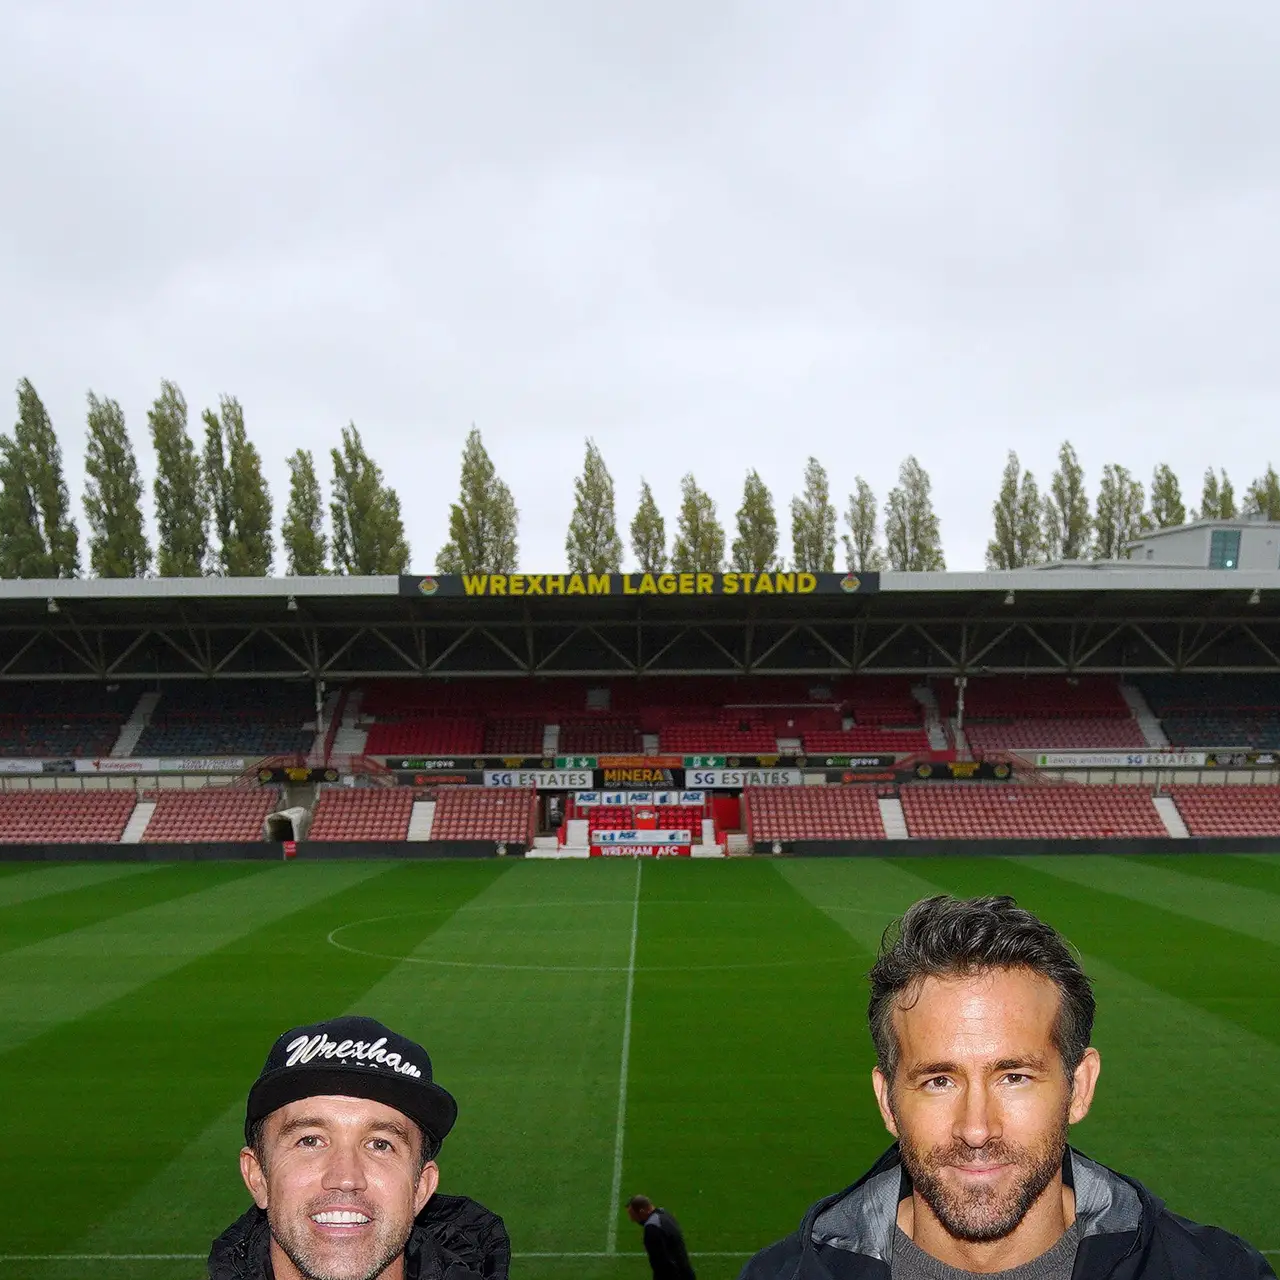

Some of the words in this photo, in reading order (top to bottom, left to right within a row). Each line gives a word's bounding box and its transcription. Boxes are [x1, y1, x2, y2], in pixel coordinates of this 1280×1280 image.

[462, 573, 611, 596] WREXHAM
[622, 573, 715, 595] LAGER
[721, 572, 817, 595] STAND
[1126, 754, 1143, 765] SG
[1146, 753, 1199, 765] ESTATES
[491, 772, 512, 786] SG
[519, 772, 587, 786] ESTATES
[603, 768, 664, 782] MINERA
[694, 772, 715, 785] SG
[721, 770, 790, 785] ESTATES
[600, 845, 653, 856] WREXHAM
[656, 845, 680, 856] AFC
[286, 1033, 422, 1078] Wrexham
